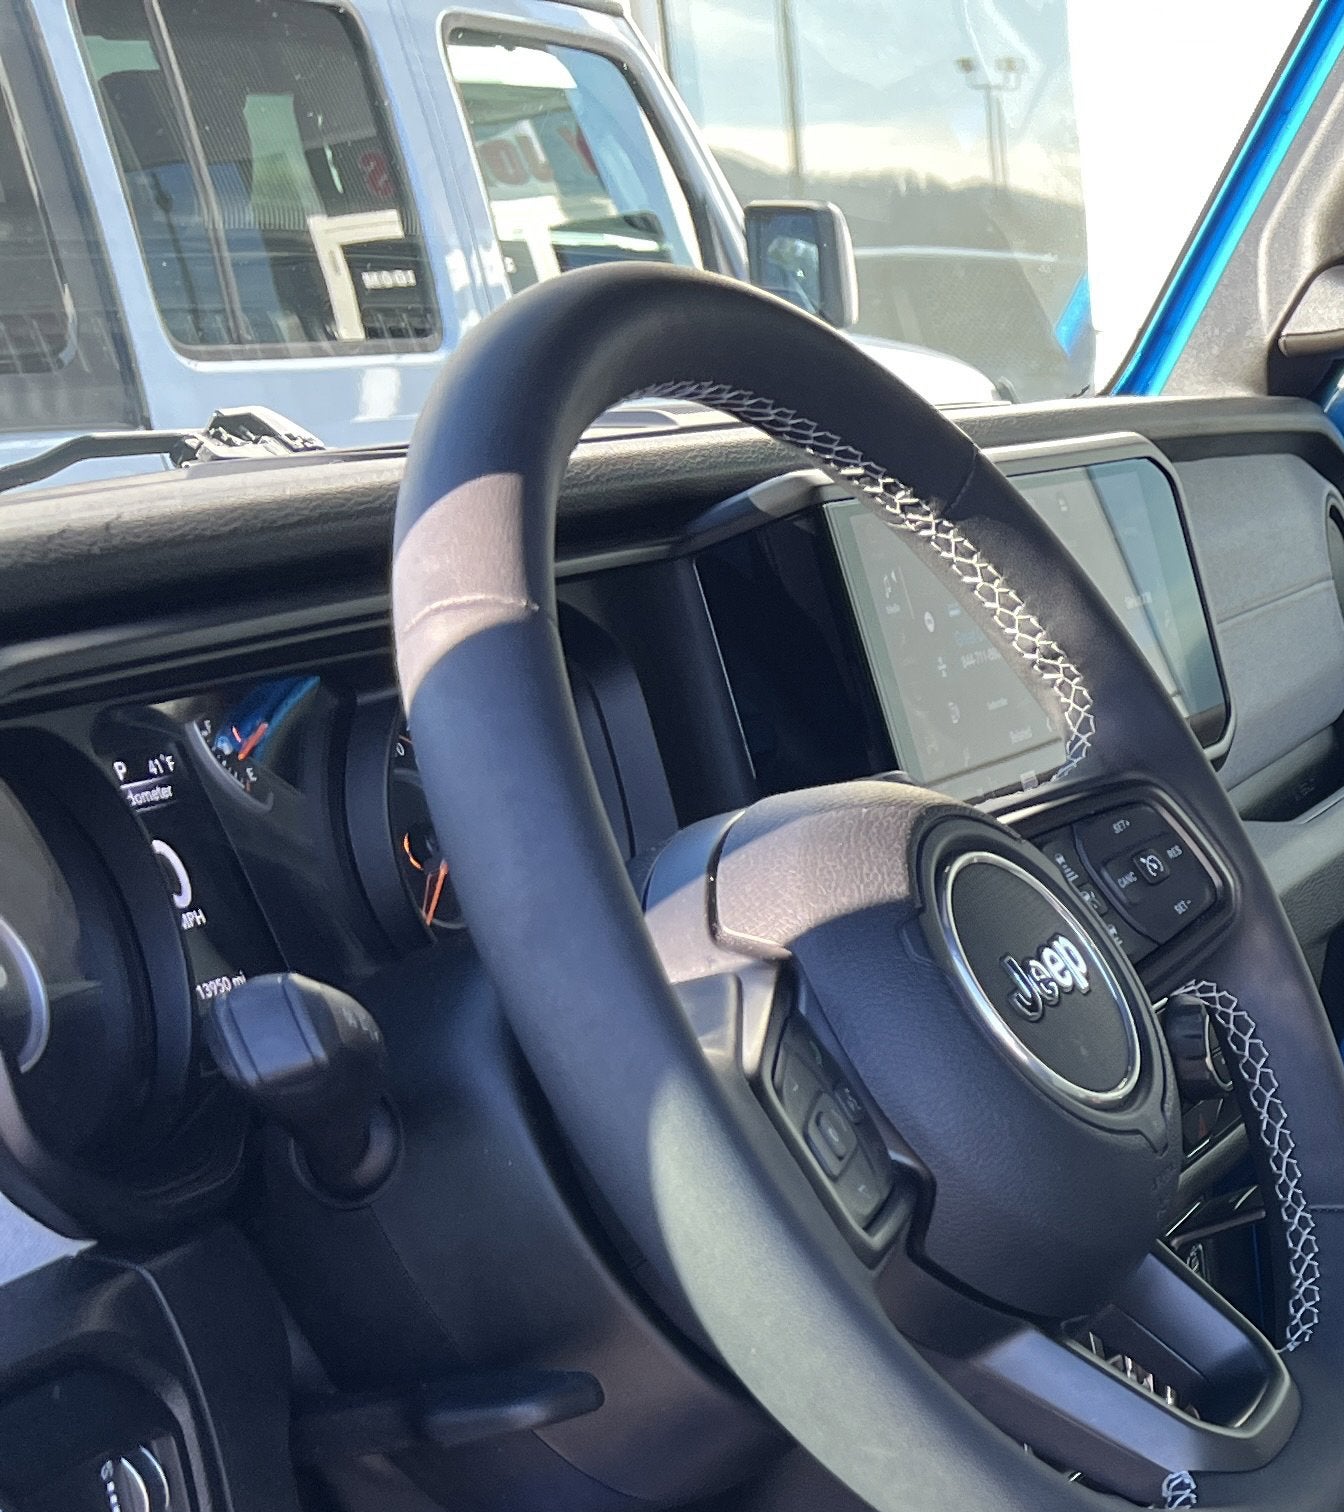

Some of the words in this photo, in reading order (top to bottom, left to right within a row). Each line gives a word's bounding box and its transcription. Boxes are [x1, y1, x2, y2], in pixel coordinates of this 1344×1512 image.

[113, 760, 128, 782] P
[1166, 844, 1183, 860] RES
[999, 931, 1091, 1023] Jeep
